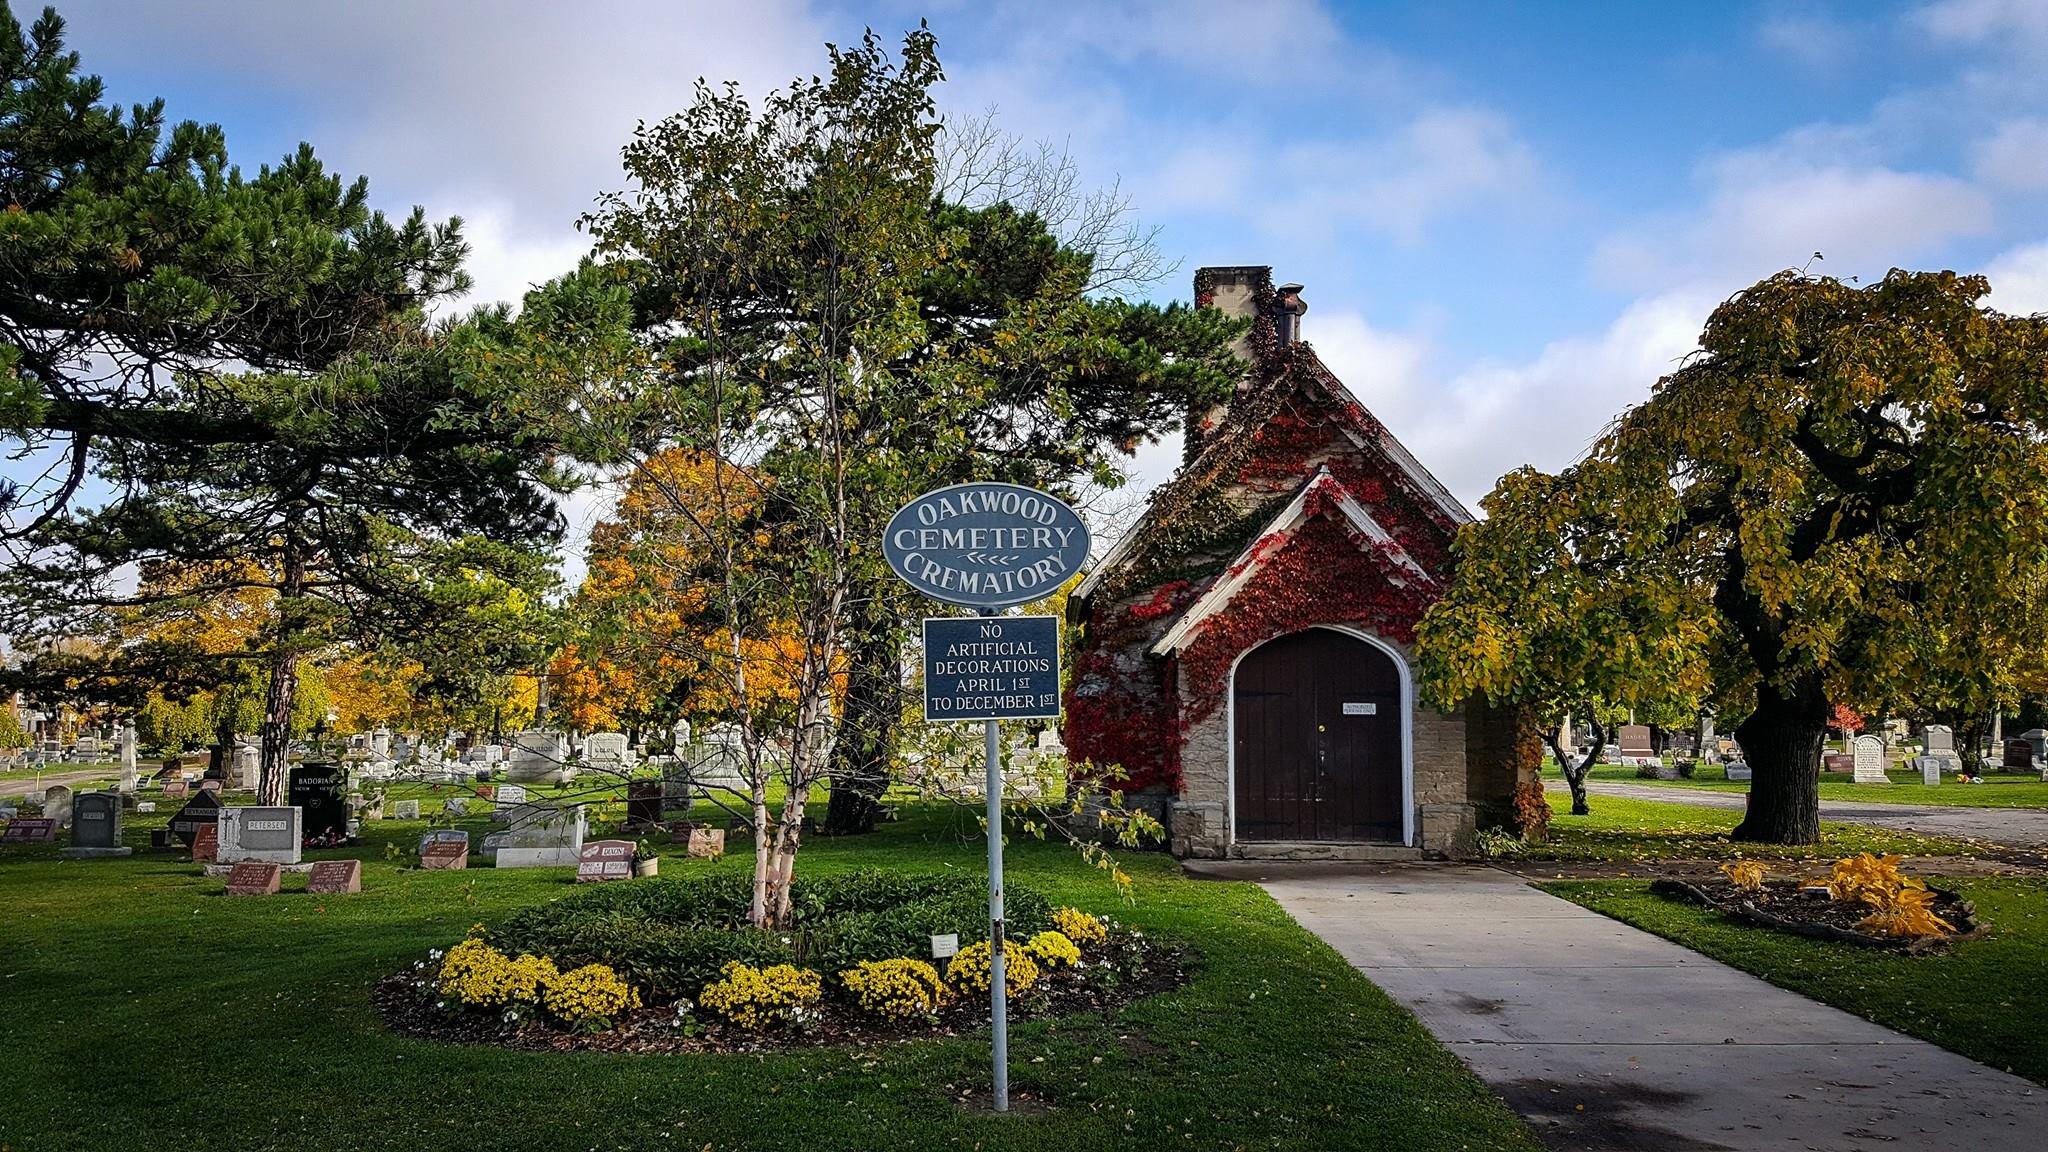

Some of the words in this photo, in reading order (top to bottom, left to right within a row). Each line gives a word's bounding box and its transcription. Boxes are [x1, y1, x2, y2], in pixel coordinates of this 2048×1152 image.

[917, 490, 1057, 526] OAKWOOD
[893, 526, 1077, 551] CEMETERY
[903, 550, 1068, 594] CREMATORY
[980, 624, 1002, 639] NO
[946, 641, 1038, 657] ARTIFICIAL
[935, 658, 1050, 675] DECORATIONS
[955, 678, 1006, 693] APRIL
[1012, 677, 1031, 691] 1ST
[931, 697, 952, 711] TO
[956, 694, 1036, 710] DECEMBER
[1039, 692, 1056, 708] 1ST
[249, 821, 285, 829] PETERSEN
